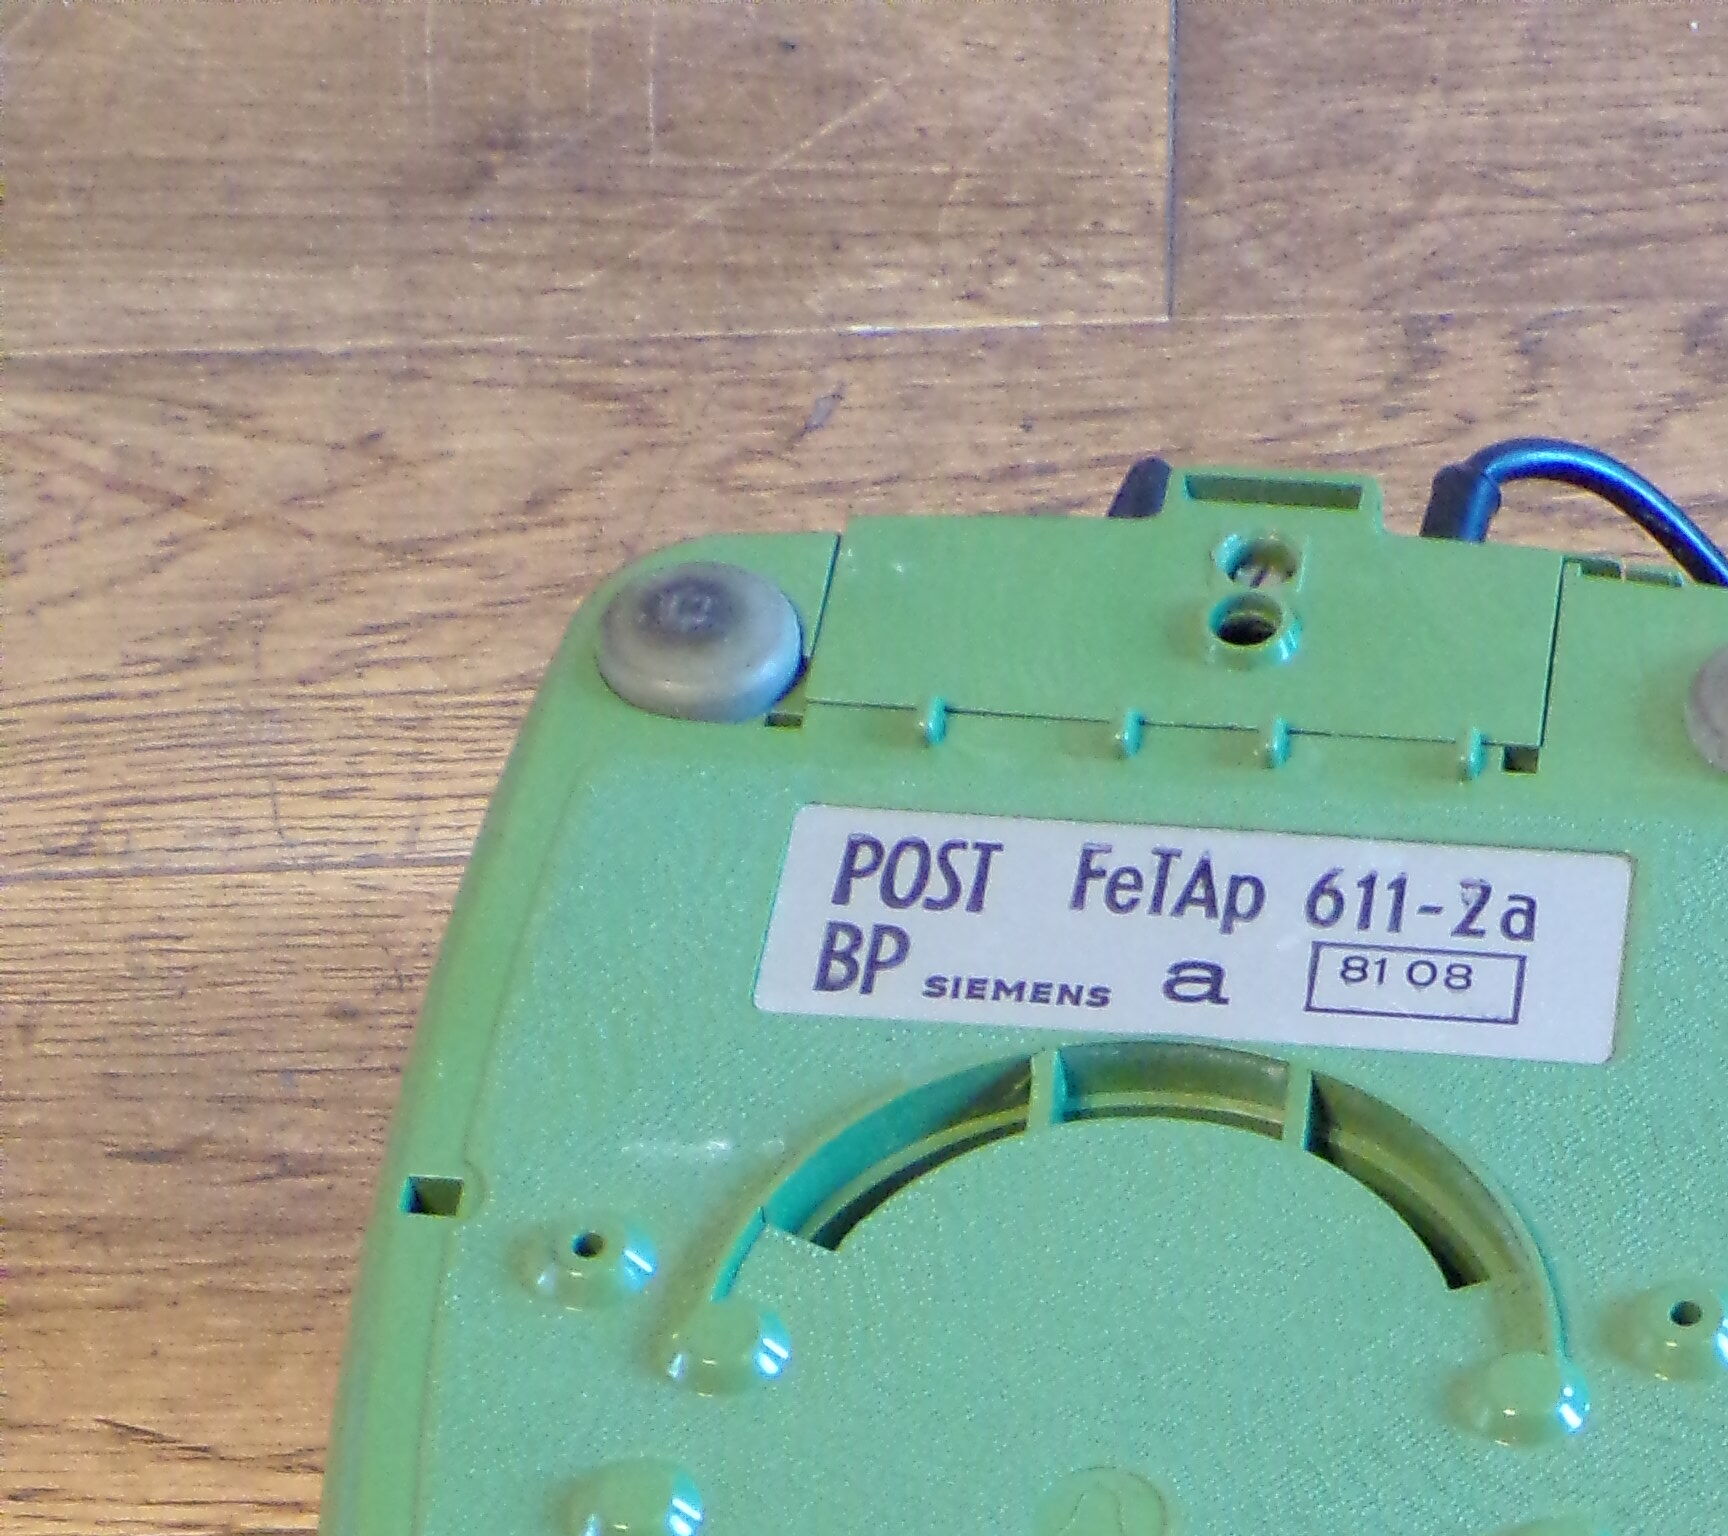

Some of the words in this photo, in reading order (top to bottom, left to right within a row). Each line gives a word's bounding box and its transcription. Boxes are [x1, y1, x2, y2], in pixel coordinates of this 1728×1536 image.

[830, 832, 1004, 913] POST
[1070, 841, 1266, 935] FeTAp
[1304, 866, 1538, 942] 611-2a
[812, 919, 911, 996] BP
[922, 974, 1112, 1008] SIEMENS
[1162, 959, 1230, 1006] a
